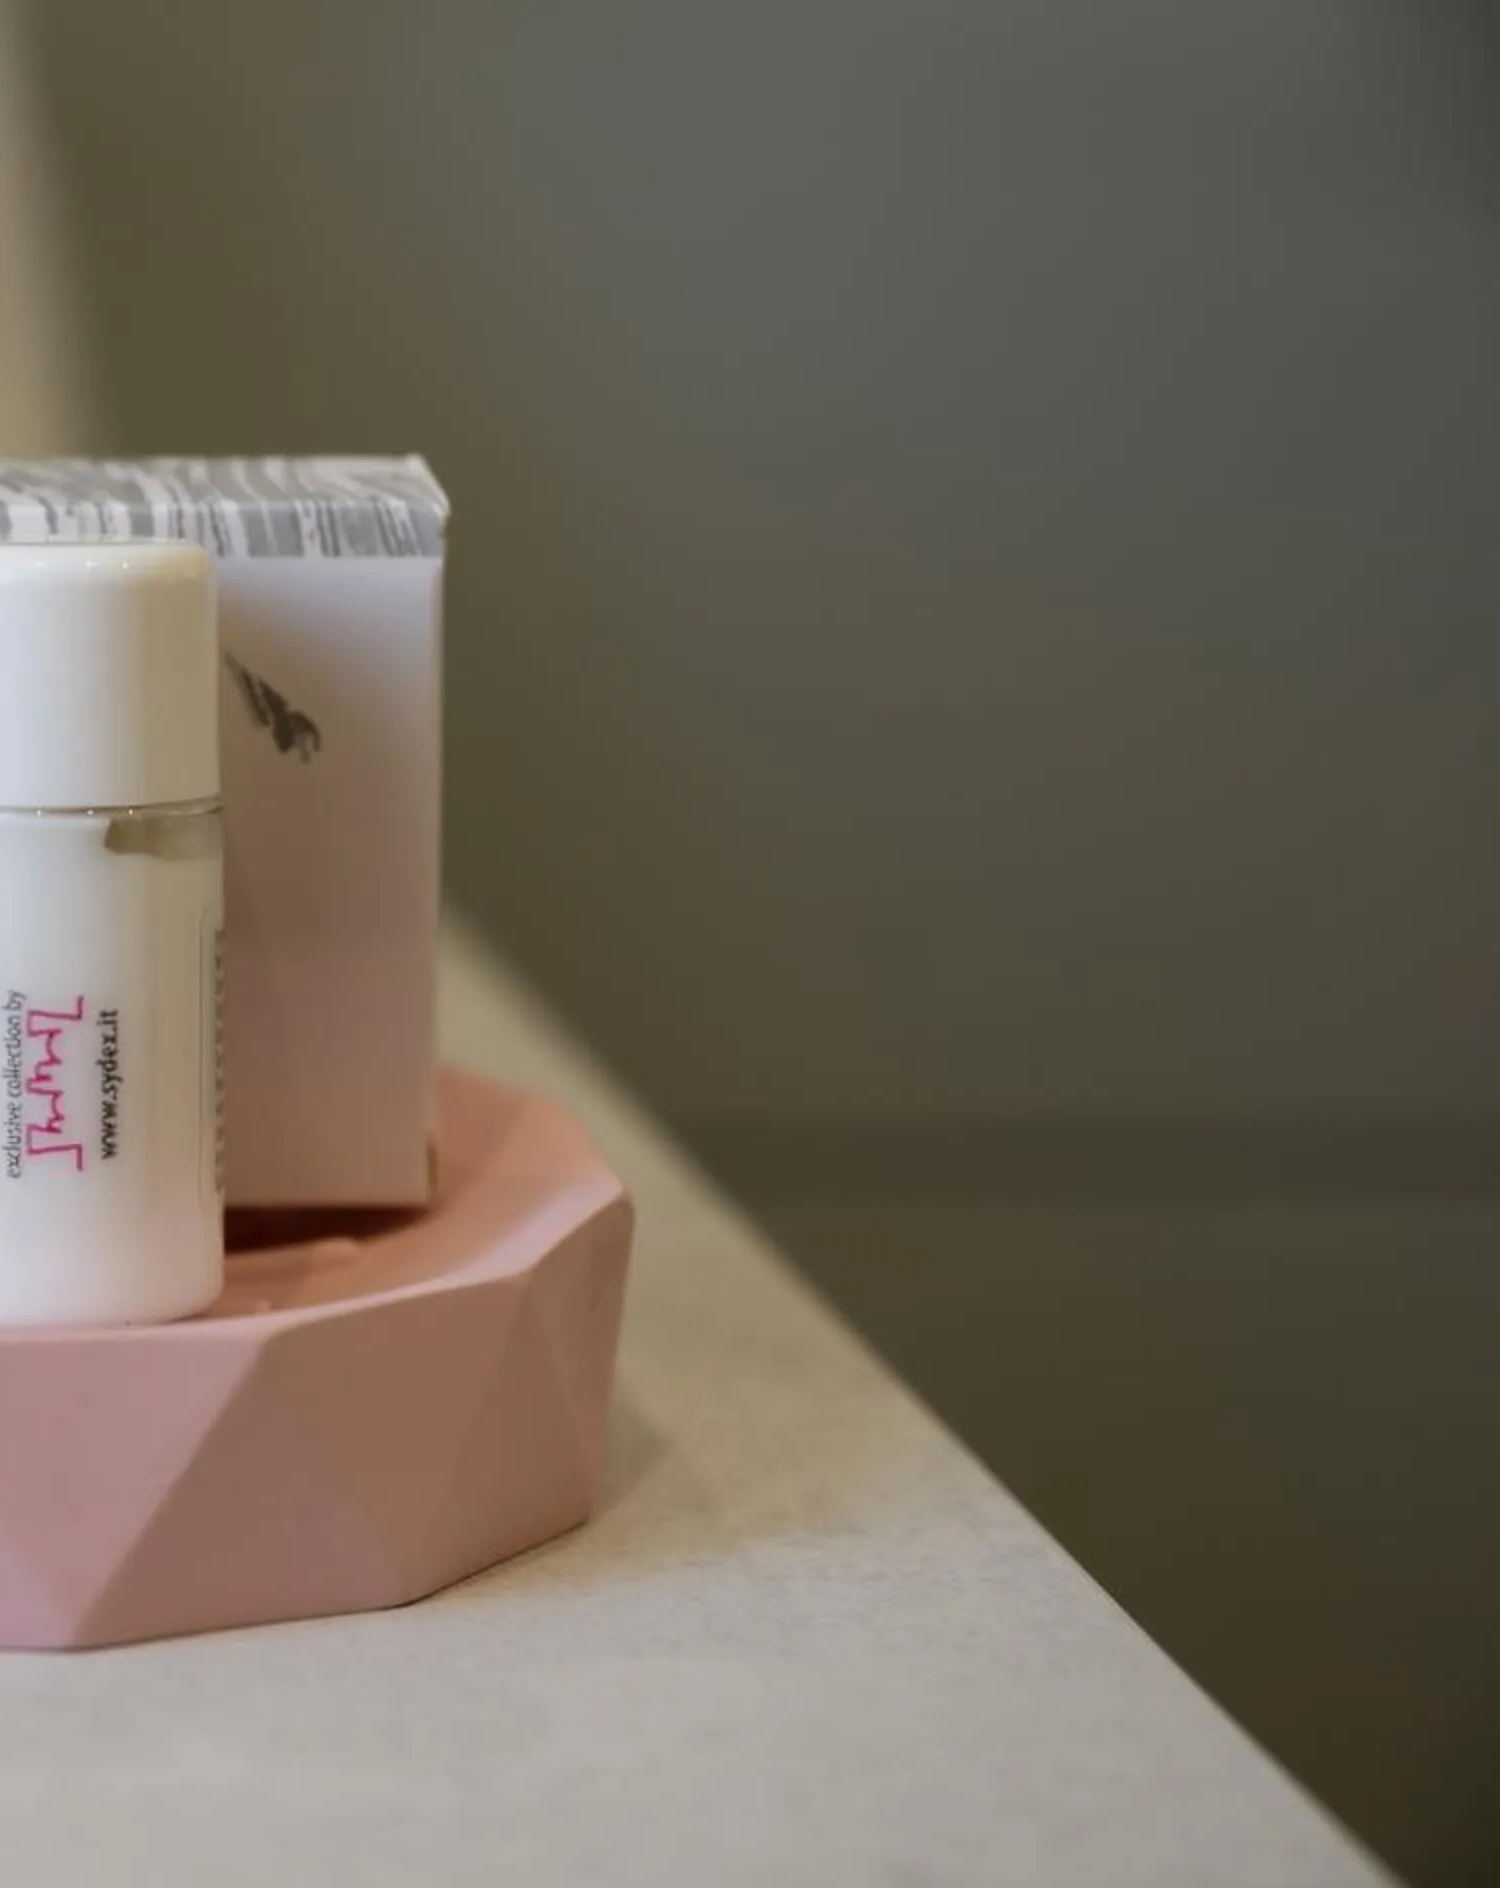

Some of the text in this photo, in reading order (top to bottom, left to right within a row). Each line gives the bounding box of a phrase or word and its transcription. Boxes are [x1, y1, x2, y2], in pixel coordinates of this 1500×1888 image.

[2, 990, 27, 1179] exclusive collection by
[96, 1008, 123, 1160] www.sydex.it
